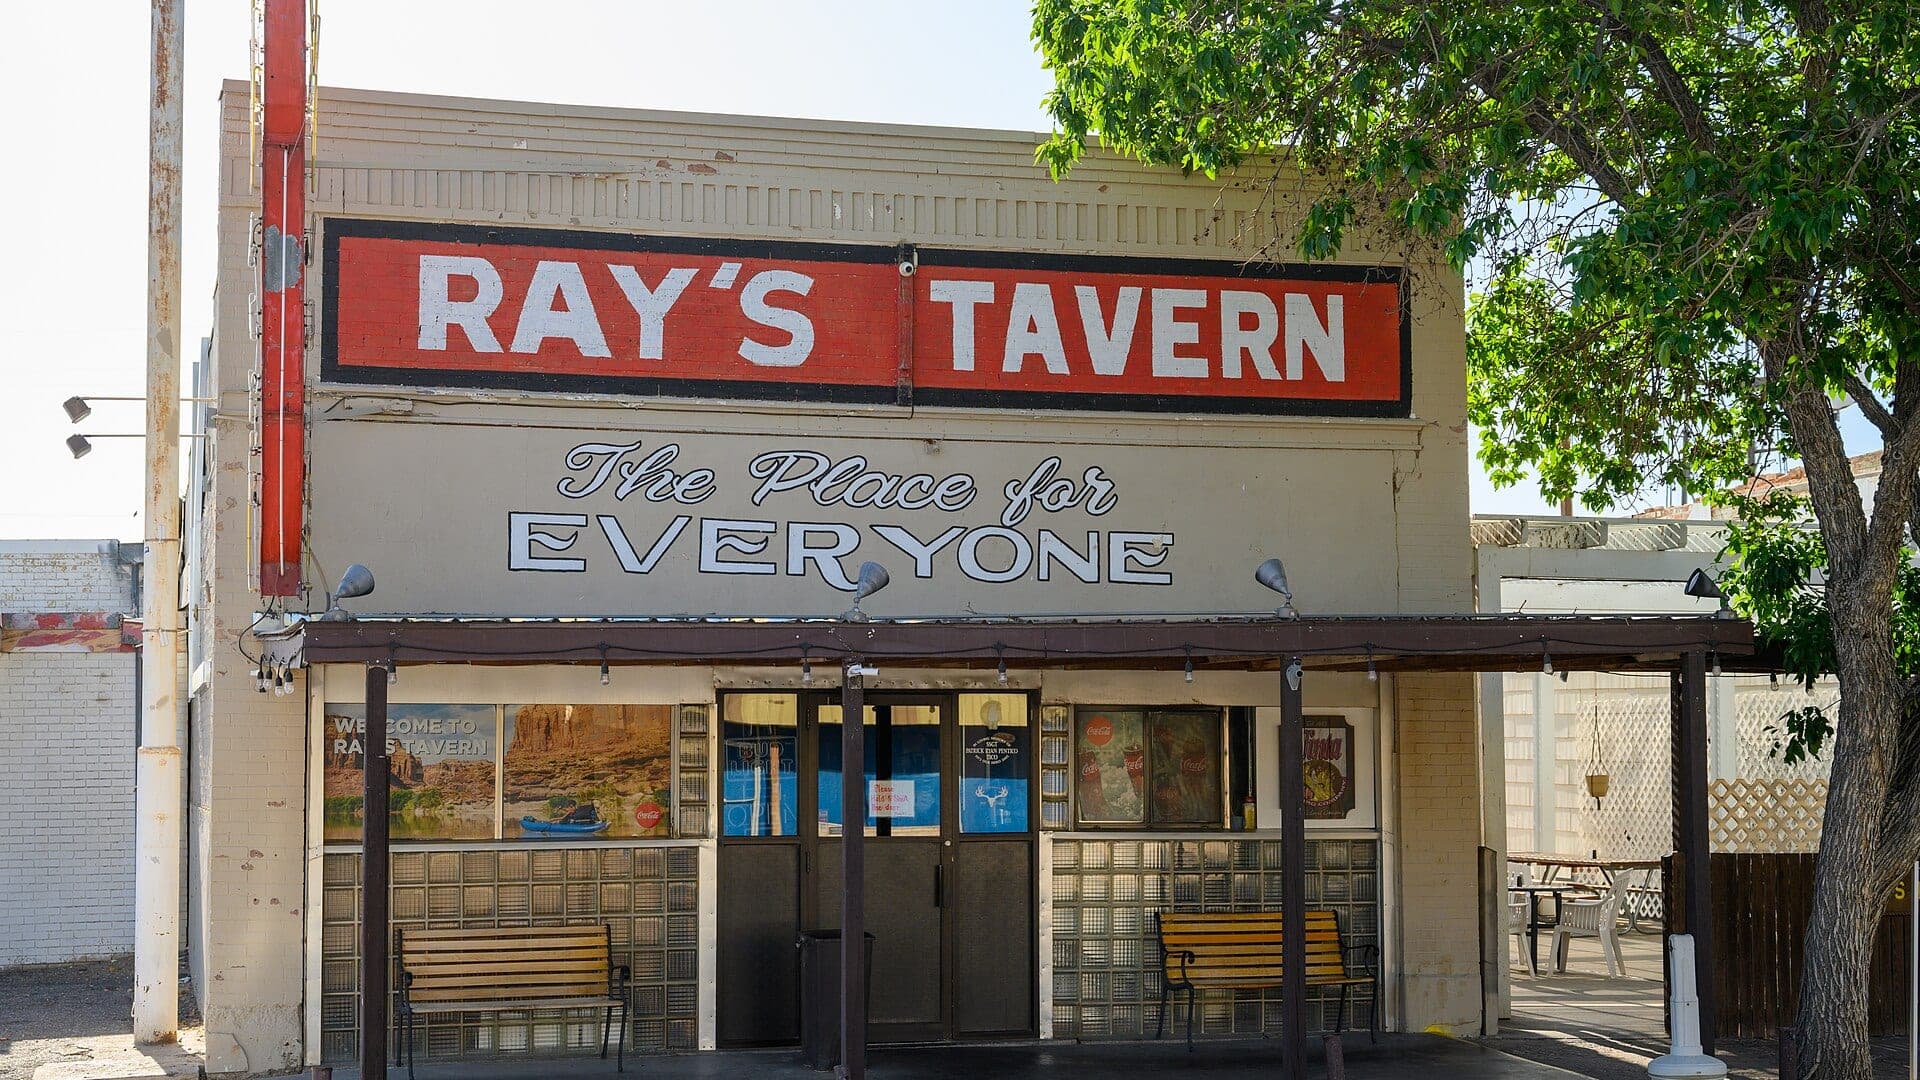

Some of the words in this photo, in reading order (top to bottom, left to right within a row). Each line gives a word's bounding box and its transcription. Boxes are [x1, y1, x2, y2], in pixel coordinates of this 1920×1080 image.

[417, 254, 816, 367] RAY'S
[929, 279, 1346, 382] TAVERN
[556, 440, 716, 504] The
[749, 450, 977, 511] Place
[1000, 456, 1118, 527] for
[508, 511, 1175, 592] EVERYONE
[334, 718, 442, 735] WECOME
[448, 719, 477, 735] TO
[1086, 726, 1112, 736] Coca-Cola
[334, 739, 396, 755] RAS
[405, 739, 488, 756] TAVERN
[637, 810, 660, 820] Coca-Cola
